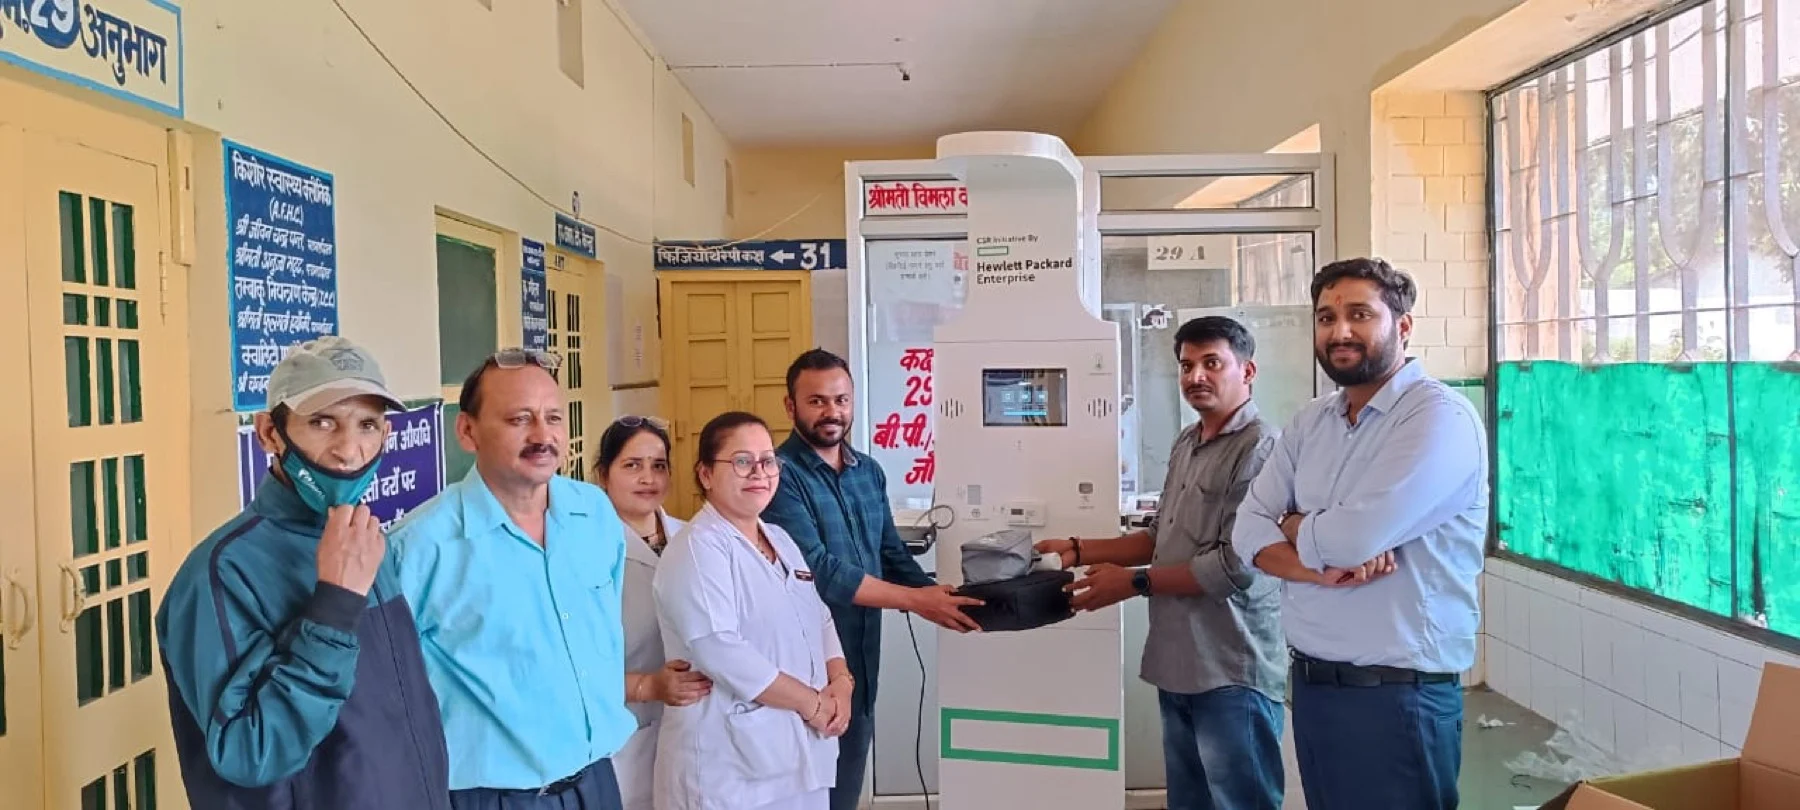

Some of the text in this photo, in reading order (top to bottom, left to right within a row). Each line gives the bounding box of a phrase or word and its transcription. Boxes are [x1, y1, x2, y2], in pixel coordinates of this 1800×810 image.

[81, 3, 166, 86] अनुभाग
[868, 183, 910, 210] श्रीमती
[911, 182, 956, 211] विमला
[1028, 234, 1039, 242] By
[800, 242, 831, 269] 31
[976, 260, 1022, 272] Hewlett
[1025, 256, 1072, 270] Packard
[1156, 246, 1204, 260] 29 A
[976, 272, 1036, 285] Enterprise
[400, 418, 431, 450] औषधि
[380, 465, 400, 497] दरों
[401, 469, 417, 491] पर
